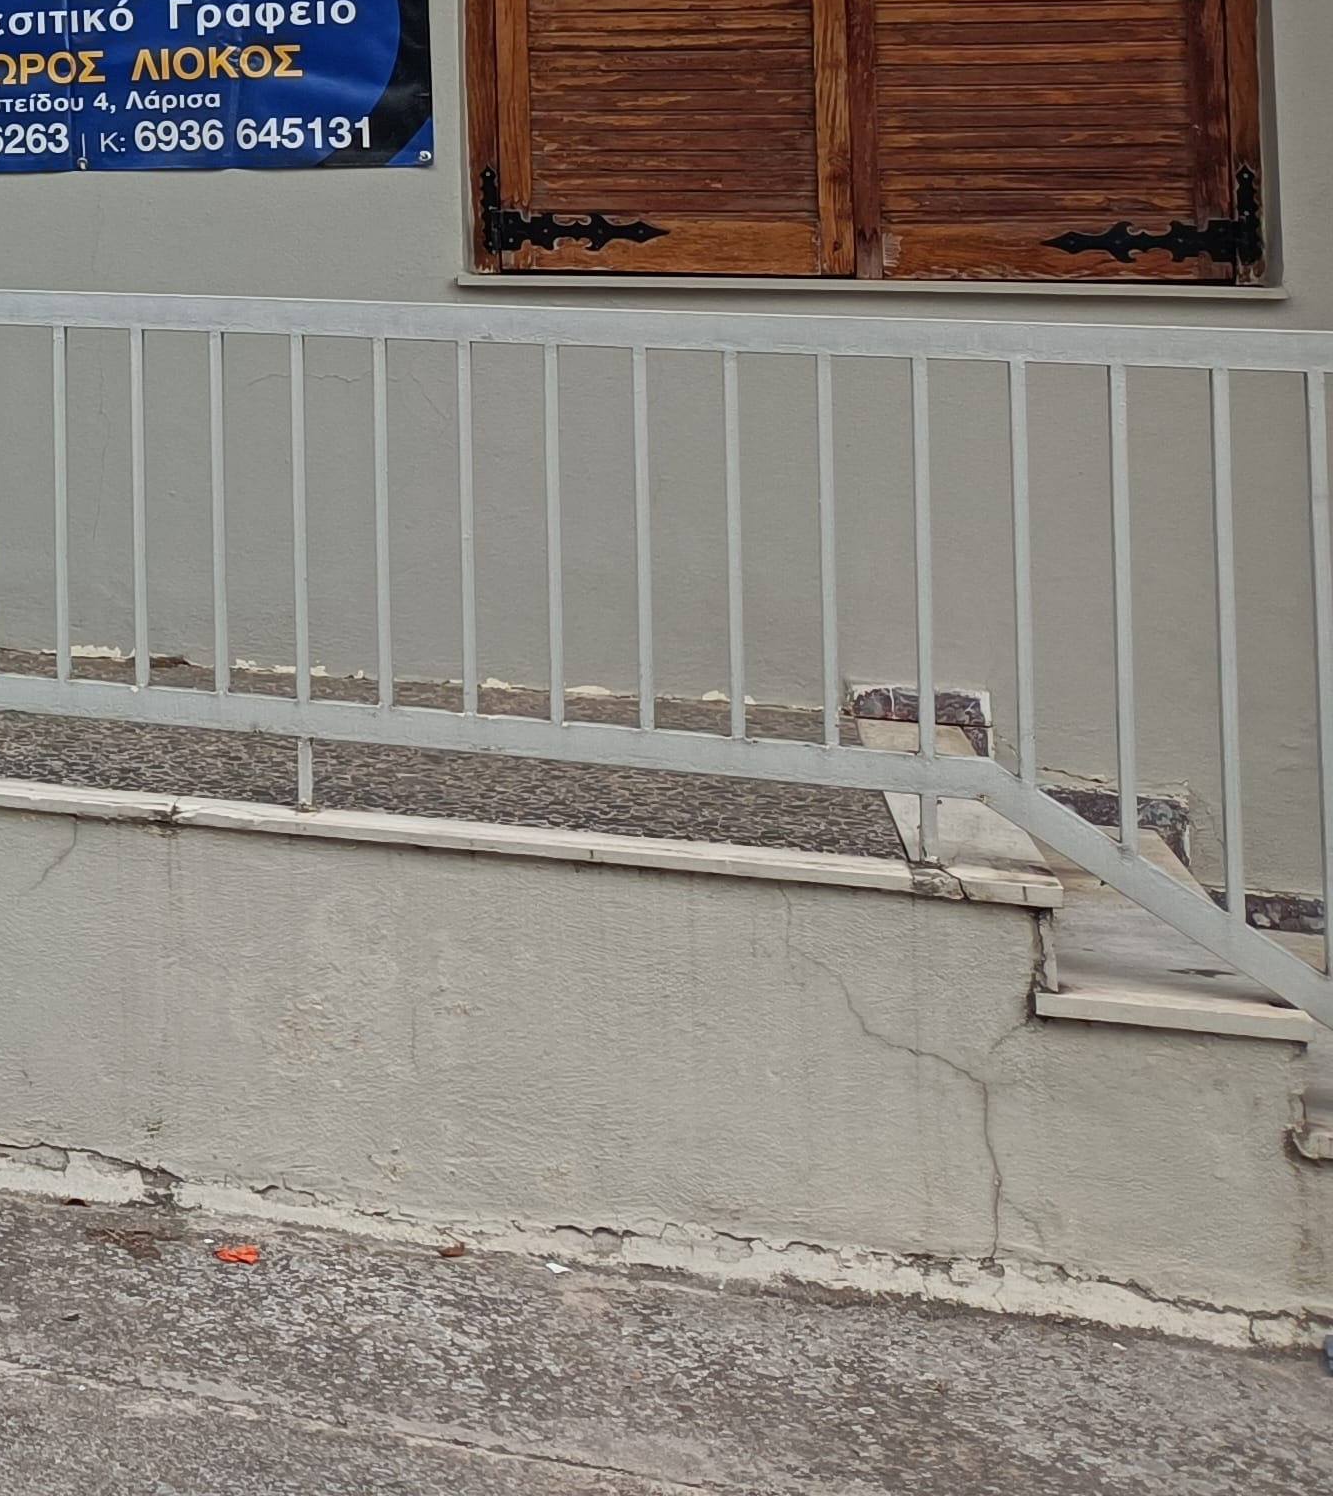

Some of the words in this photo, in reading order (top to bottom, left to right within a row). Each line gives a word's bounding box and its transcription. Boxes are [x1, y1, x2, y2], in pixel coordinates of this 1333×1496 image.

[131, 45, 303, 81] ΛΙΟΚΟΣ
[93, 92, 116, 114] 4,
[125, 90, 221, 113] Λάρισα
[134, 118, 224, 152] 6936
[236, 116, 371, 150] 645131
